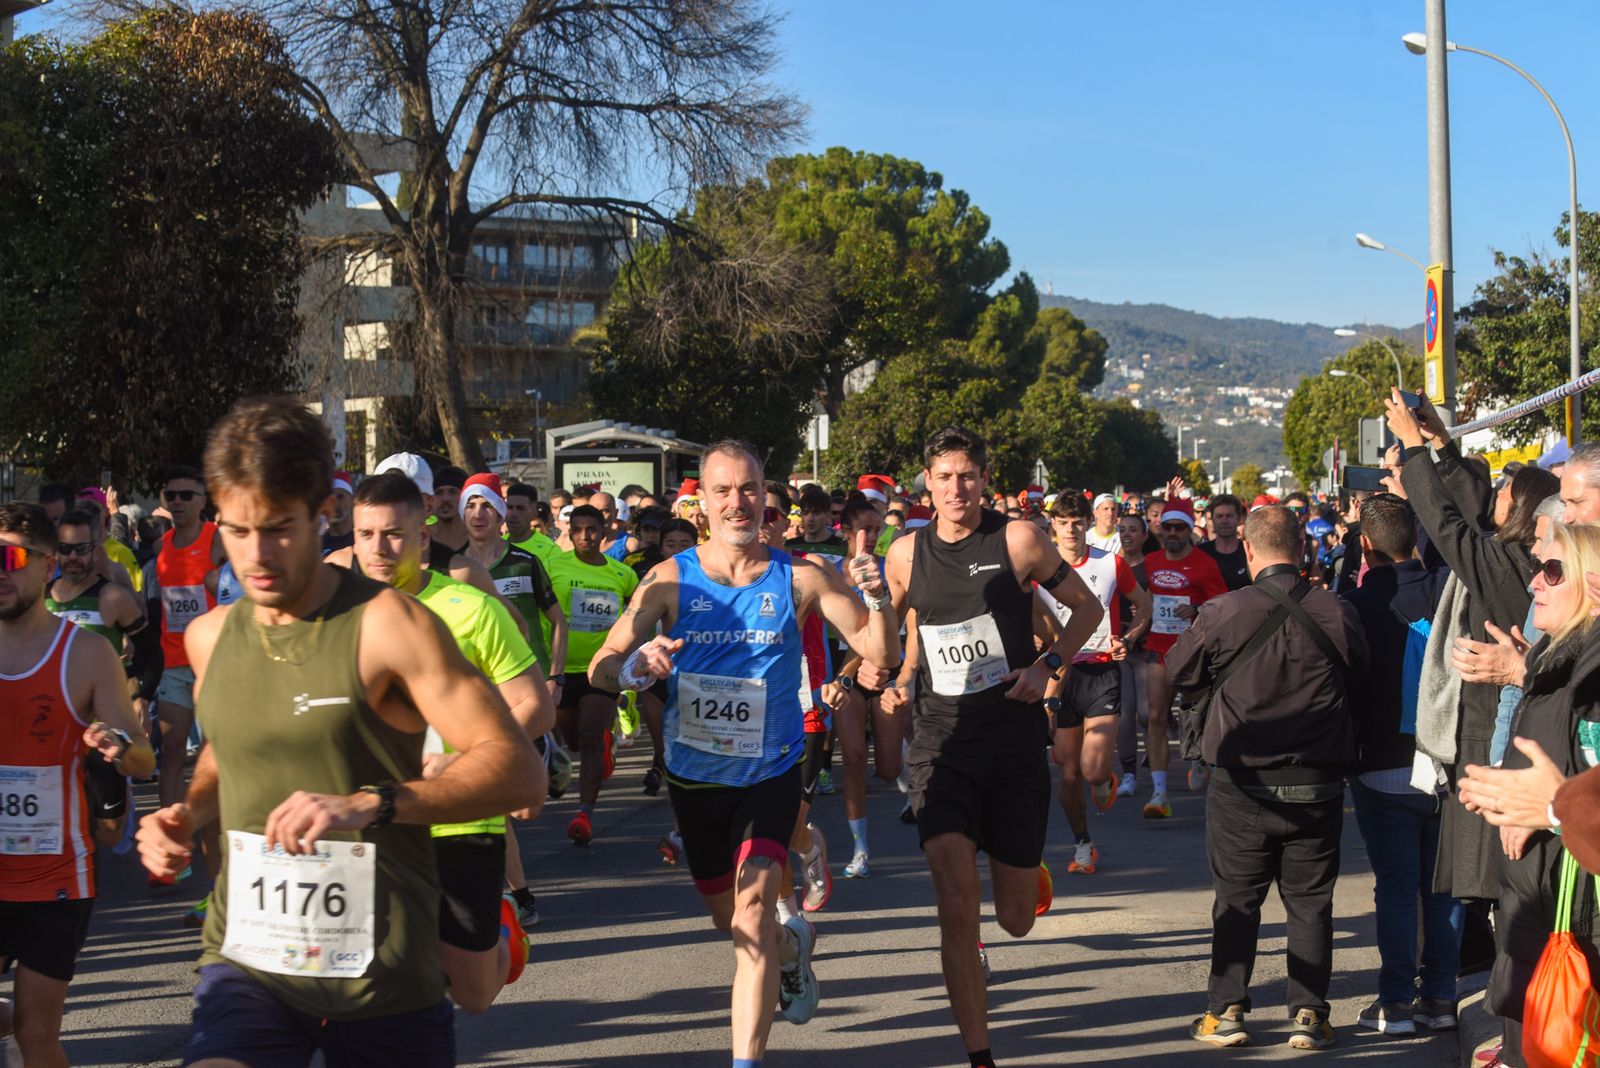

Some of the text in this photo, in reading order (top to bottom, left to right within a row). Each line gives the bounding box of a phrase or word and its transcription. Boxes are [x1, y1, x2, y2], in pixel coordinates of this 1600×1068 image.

[169, 599, 199, 613] 1260
[579, 602, 611, 616] 1464
[685, 629, 784, 644] TROTASIERRA
[938, 639, 989, 665] 1000
[691, 697, 750, 723] 1246
[0, 793, 39, 817] 86
[250, 876, 347, 918] 1176
